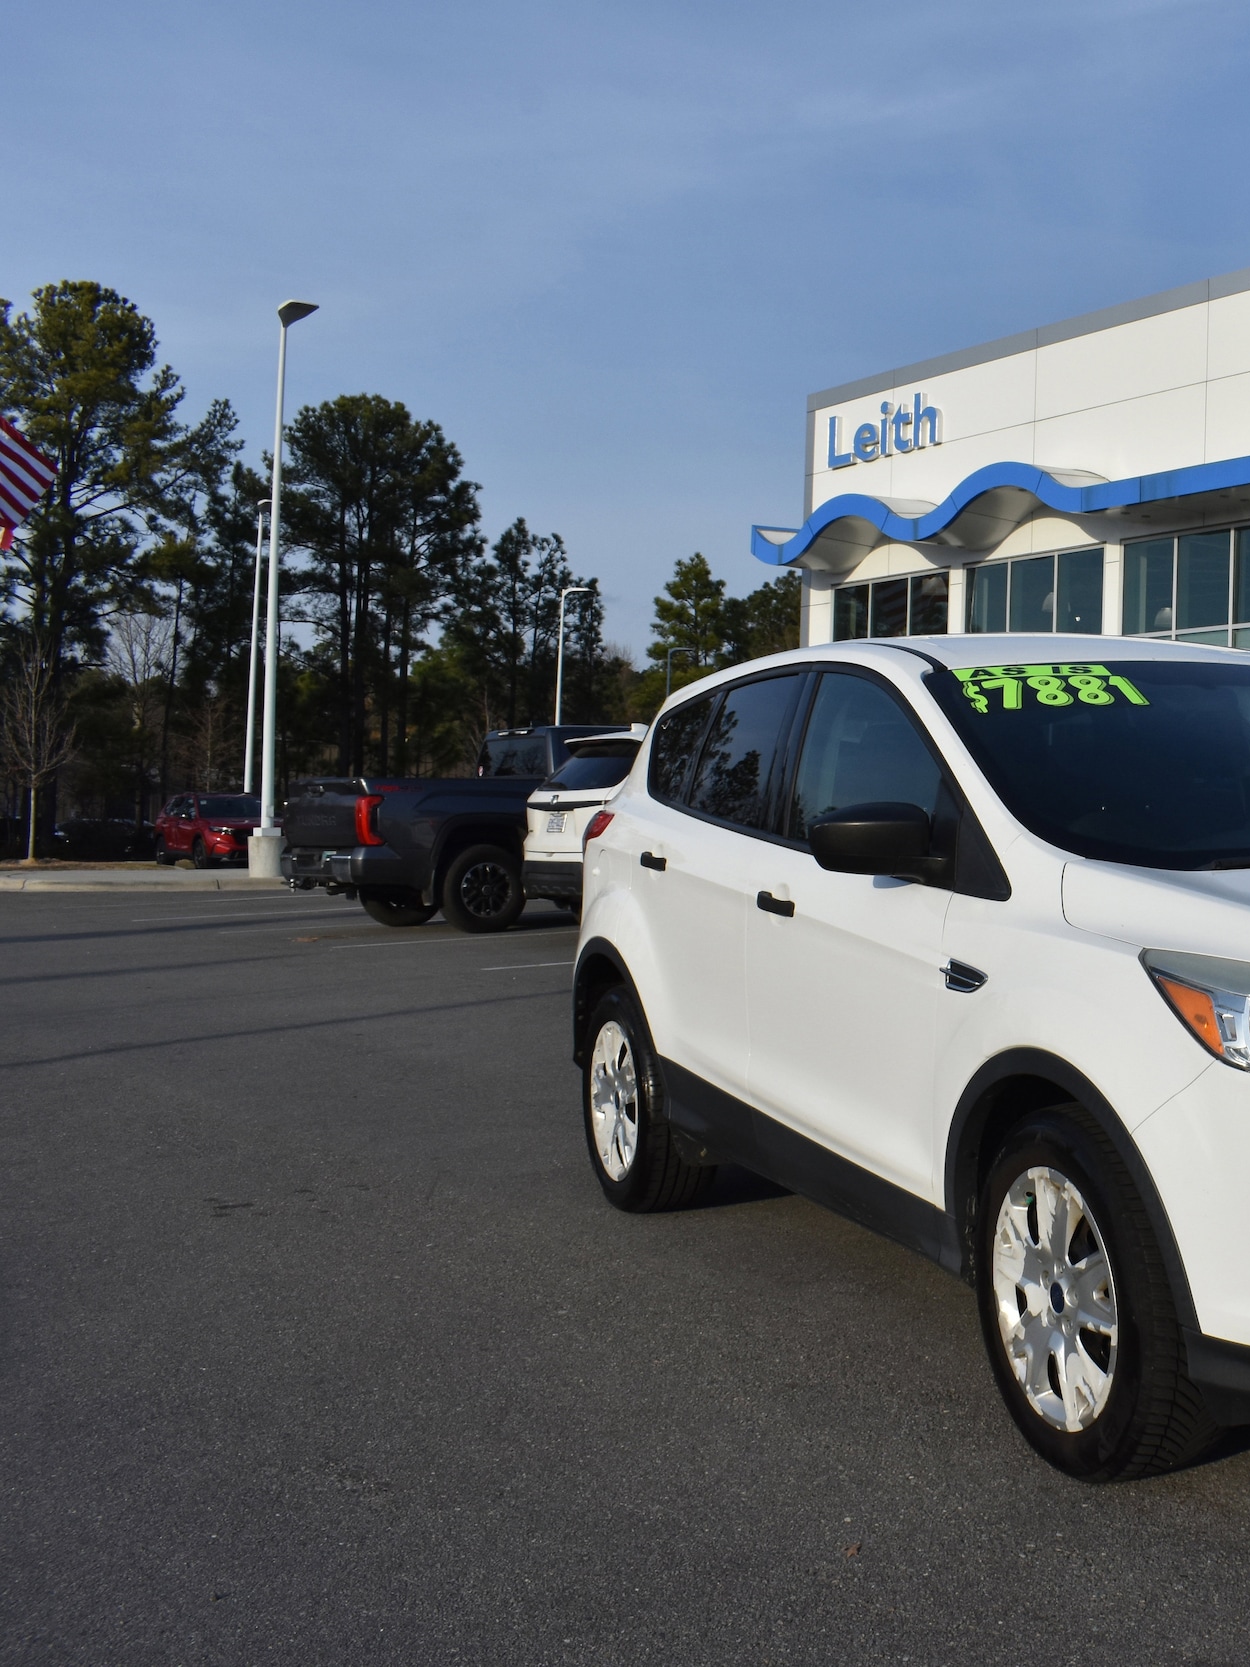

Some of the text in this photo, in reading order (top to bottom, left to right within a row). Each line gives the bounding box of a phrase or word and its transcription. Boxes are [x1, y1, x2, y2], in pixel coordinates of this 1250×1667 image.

[828, 391, 944, 470] Leith
[969, 665, 1094, 679] AS IS
[962, 675, 1150, 714] $7881
